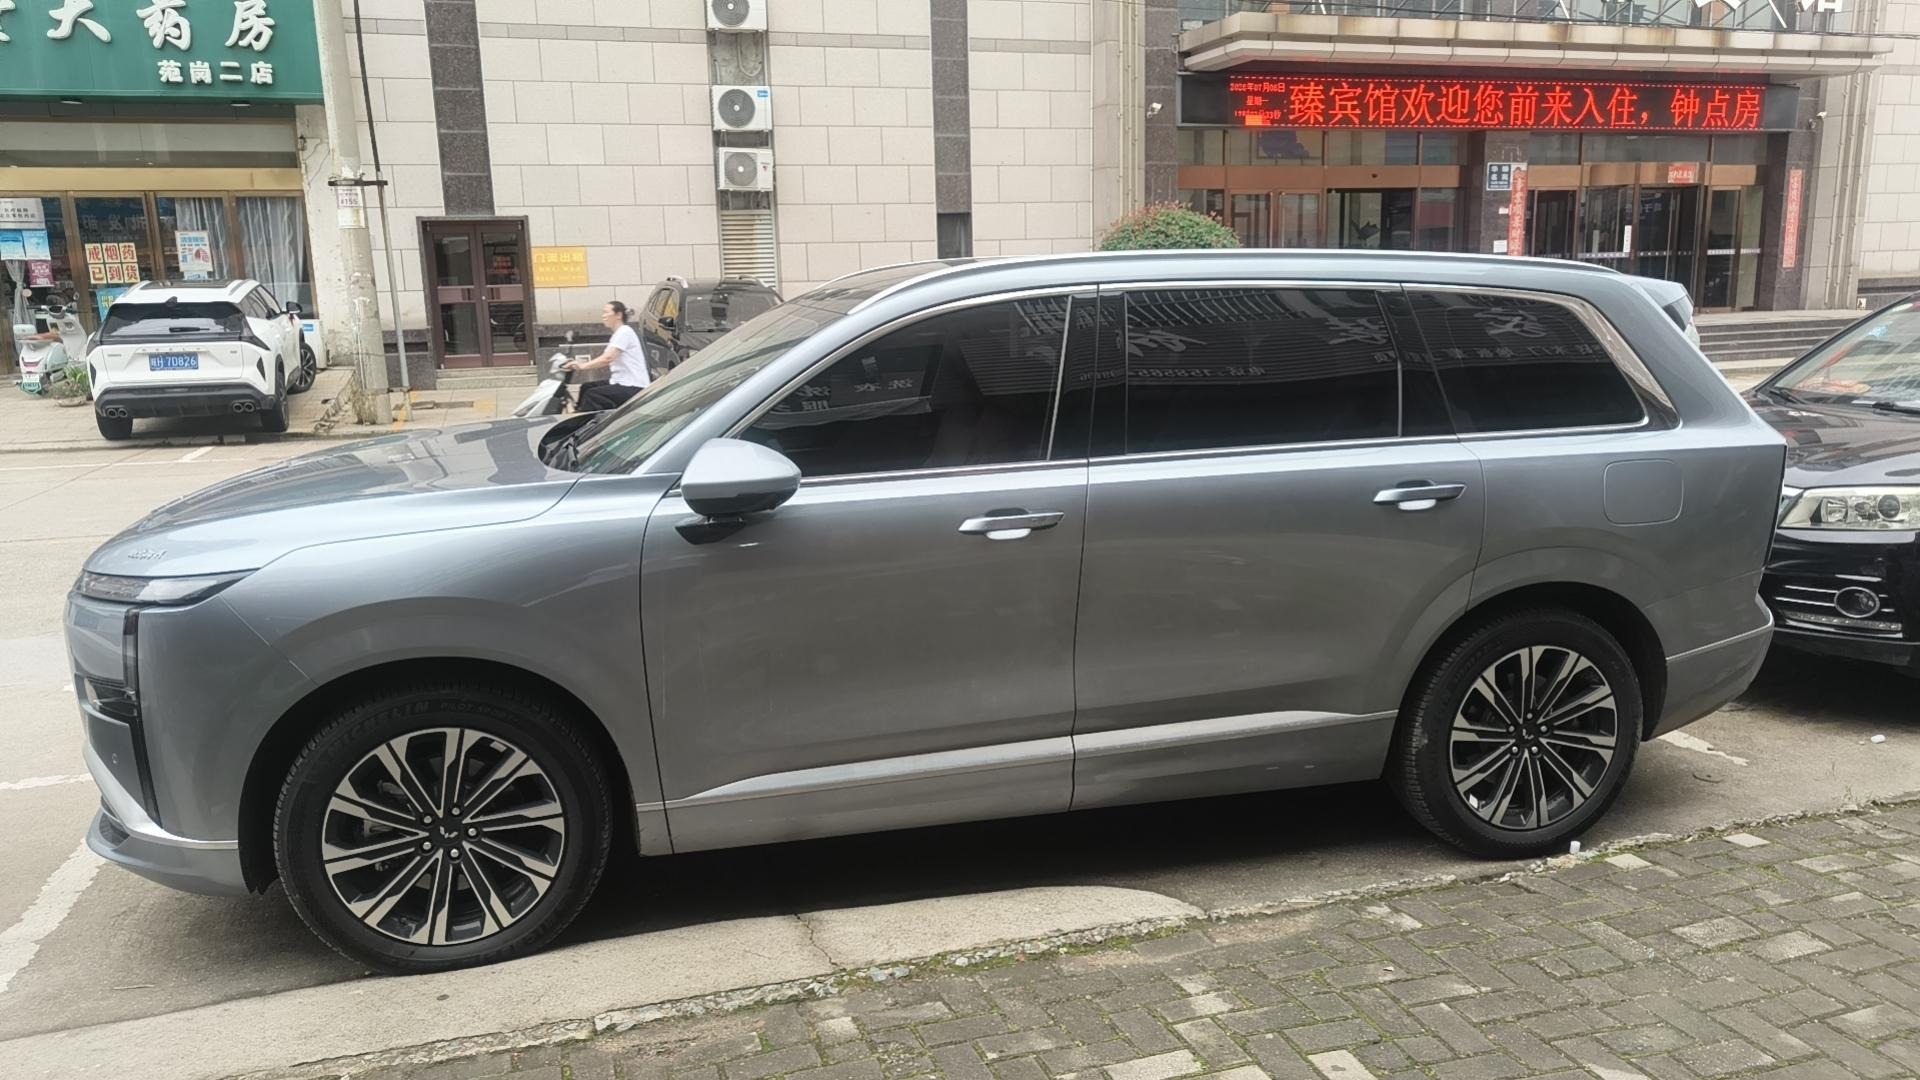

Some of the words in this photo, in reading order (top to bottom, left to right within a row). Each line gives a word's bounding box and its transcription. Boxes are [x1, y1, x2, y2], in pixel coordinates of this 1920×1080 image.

[157, 59, 273, 85] 范岗二店
[87, 245, 136, 261] 戒烟药
[91, 265, 138, 281] 已到货
